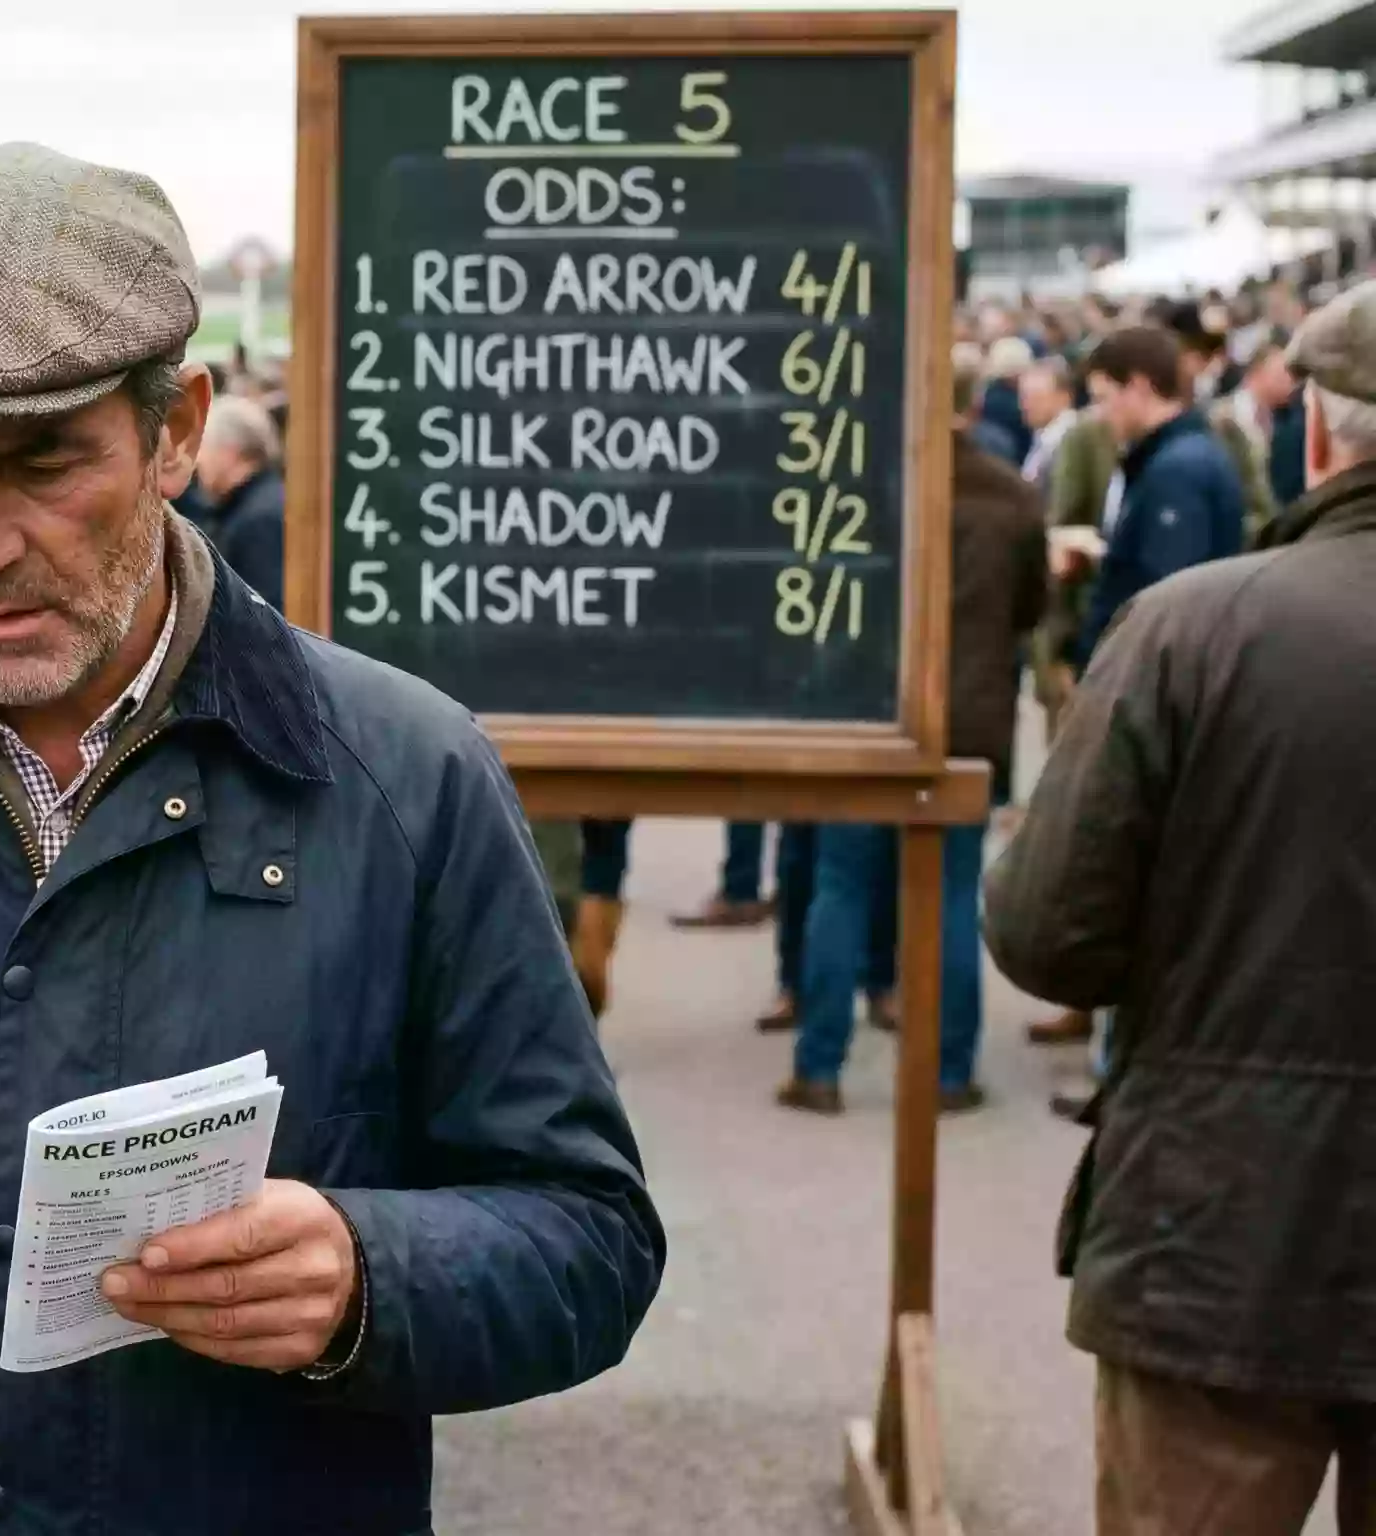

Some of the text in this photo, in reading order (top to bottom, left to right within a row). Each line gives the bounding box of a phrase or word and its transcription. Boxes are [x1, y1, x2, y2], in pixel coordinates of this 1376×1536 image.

[451, 72, 732, 145] RACE 5
[484, 166, 686, 226] ODDS:
[354, 242, 871, 325] 1. RED ARROW 4/1
[346, 326, 865, 405] 2. NIGHTHAWK 6/1
[346, 405, 865, 481] 3. SILK ROAD 3/1
[343, 482, 872, 563] 4. SHADOW 9/2
[344, 560, 863, 644] 5. KISMET 8/1
[43, 1140, 117, 1161] RACE
[124, 1105, 258, 1154] PROGRAM
[98, 1151, 200, 1181] EPSOM DOWNS
[70, 1189, 101, 1199] RACE
